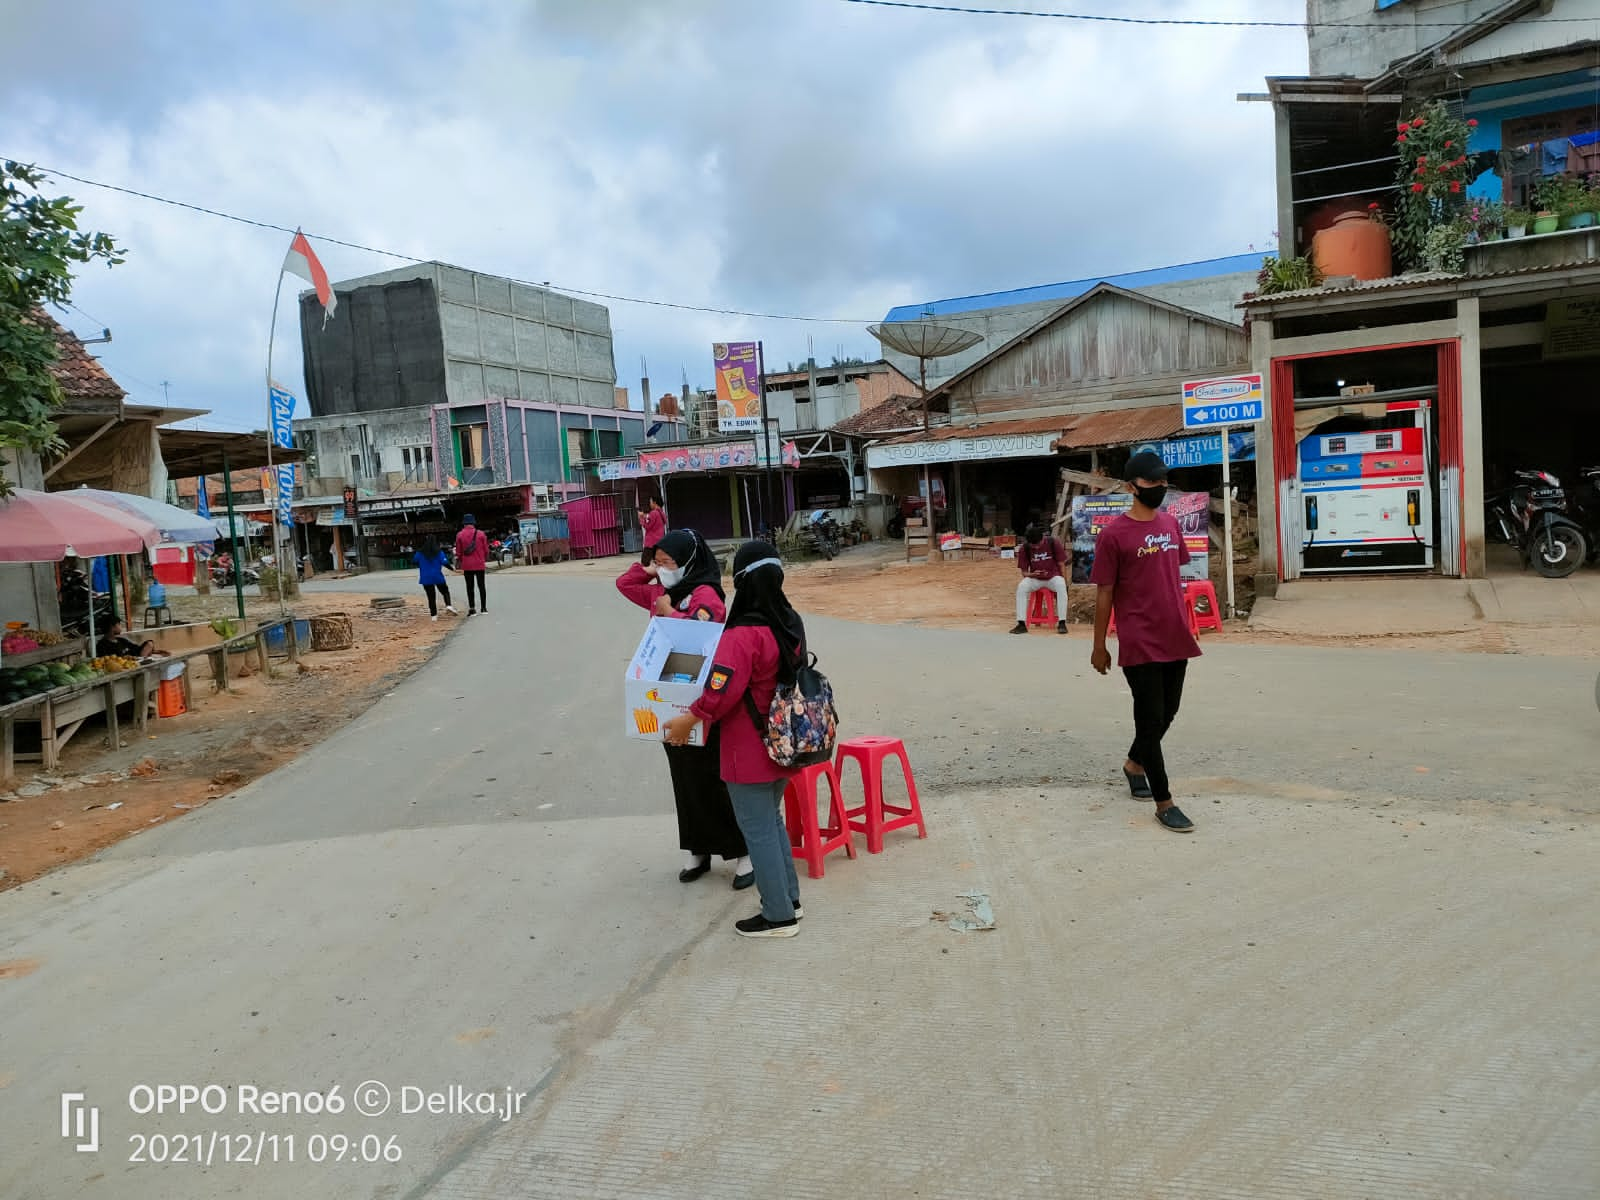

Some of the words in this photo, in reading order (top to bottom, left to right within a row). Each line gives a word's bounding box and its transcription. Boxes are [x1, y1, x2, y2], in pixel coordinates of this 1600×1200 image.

[1210, 406, 1238, 420] 100
[1243, 403, 1256, 417] M
[736, 419, 758, 427] EDWIN
[885, 442, 950, 460] TOKO
[959, 435, 1044, 455] EDWIN
[1162, 442, 1187, 455] NEW
[1189, 438, 1221, 453] STYLE
[1163, 454, 1176, 466] OF
[1177, 452, 1202, 465] MILD
[1145, 533, 1171, 547] Peduli
